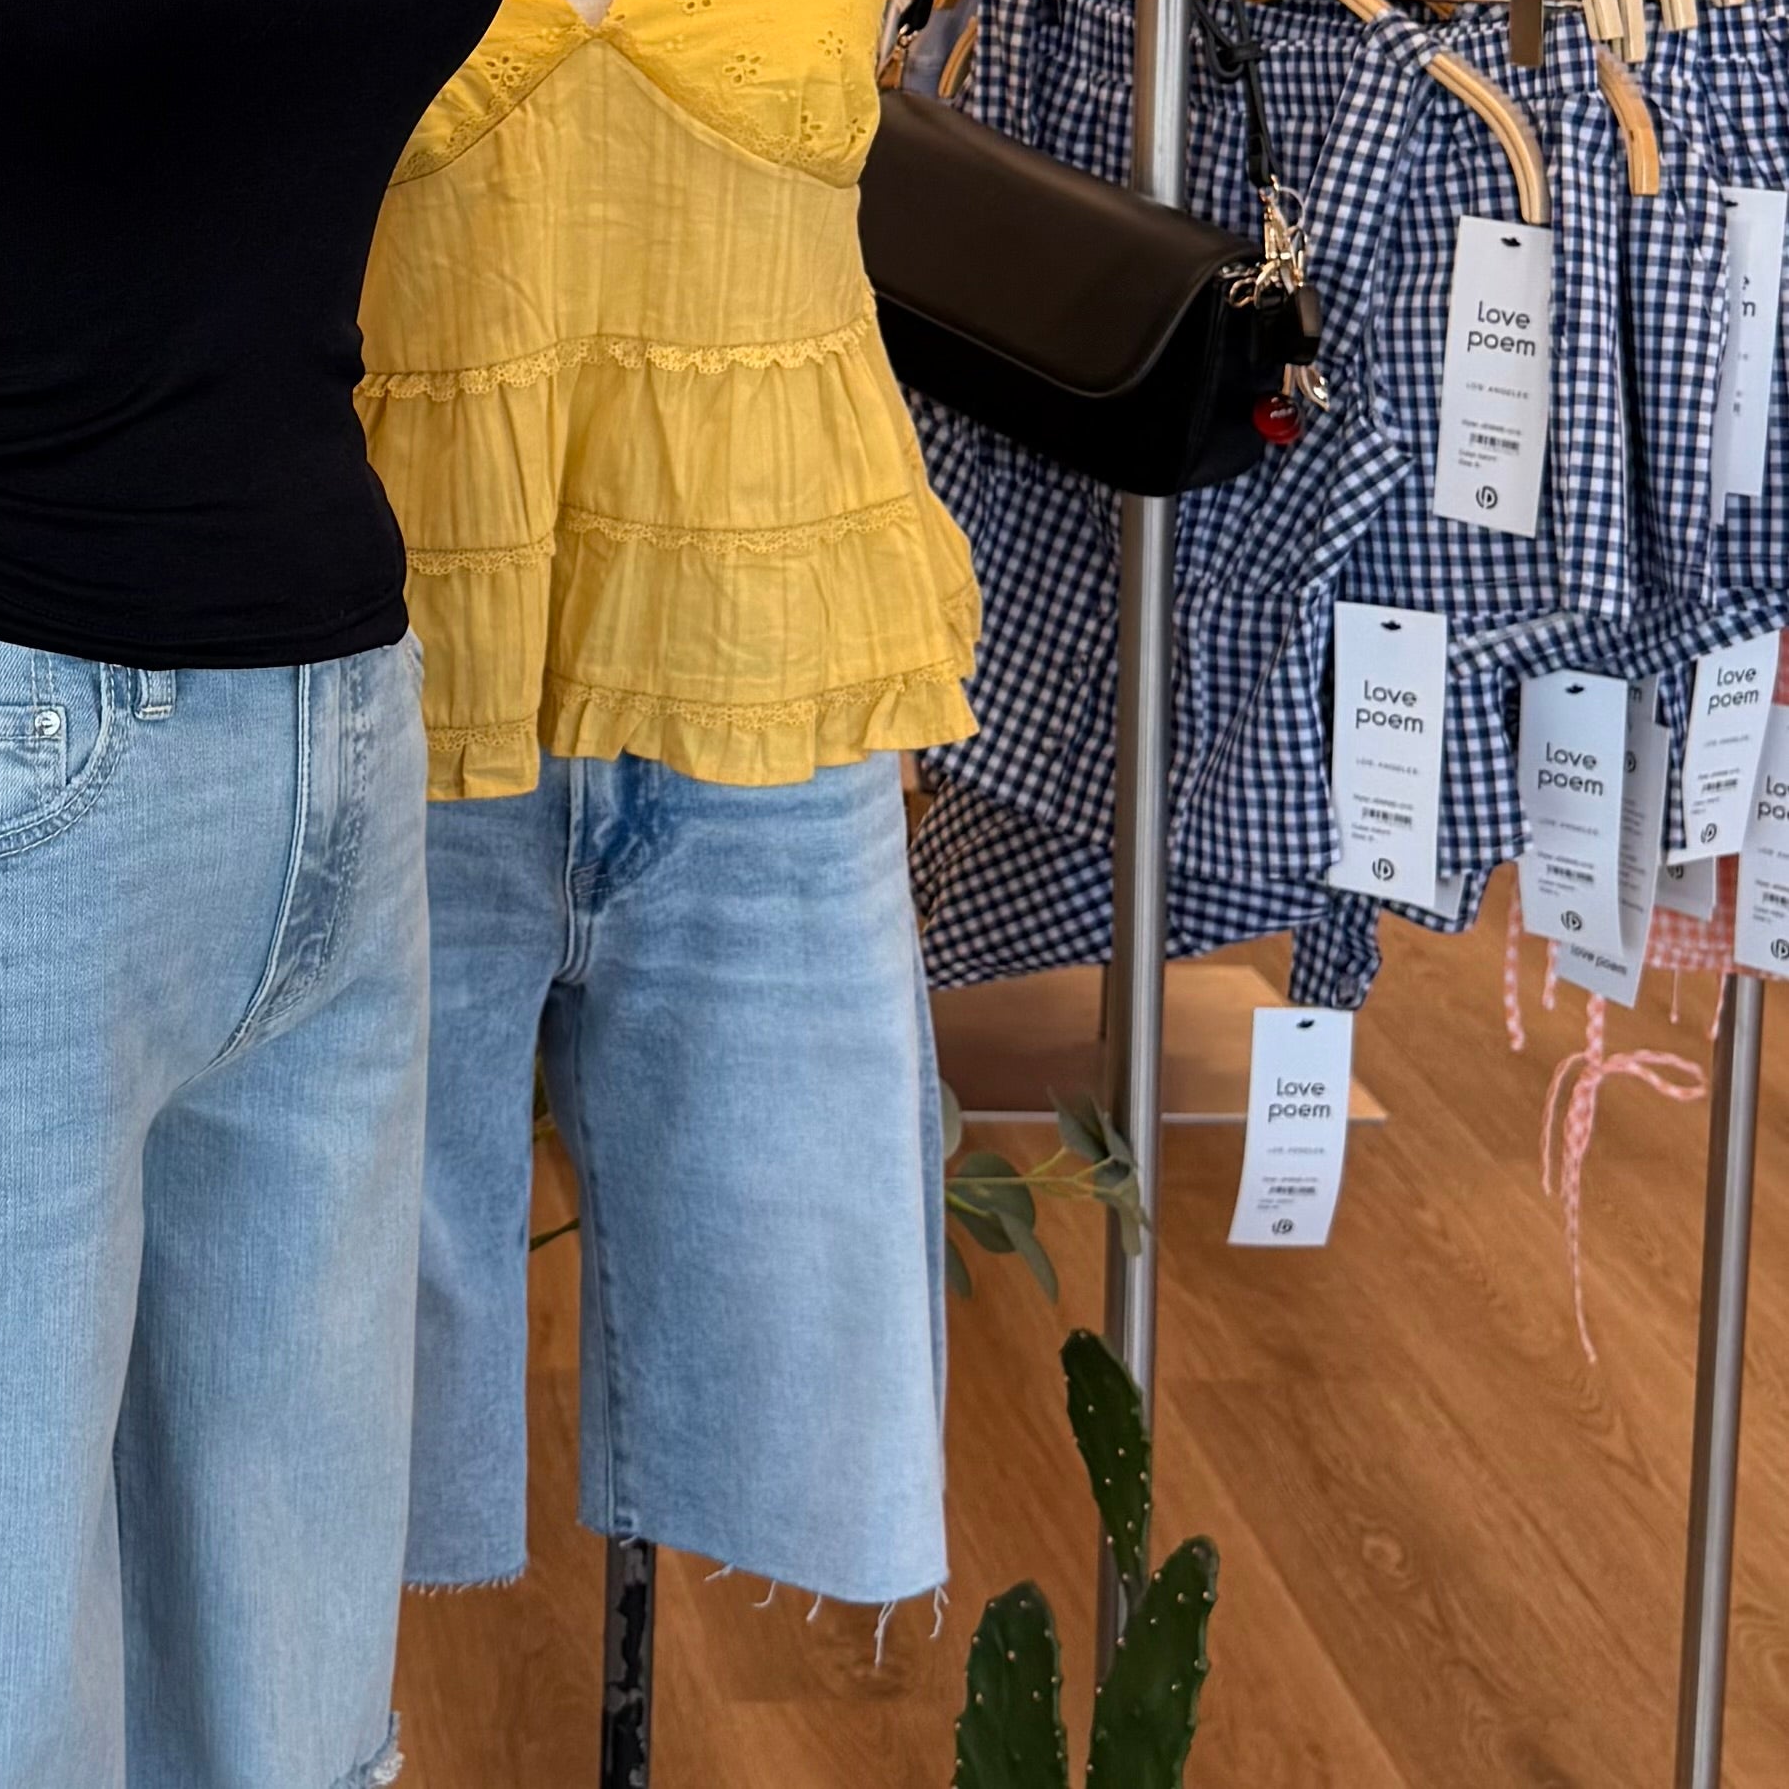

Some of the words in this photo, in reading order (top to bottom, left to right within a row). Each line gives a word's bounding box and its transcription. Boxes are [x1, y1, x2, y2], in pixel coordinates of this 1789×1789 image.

[1467, 331, 1537, 356] poem
[1707, 689, 1759, 713] poem
[1355, 708, 1423, 733] poem
[1537, 769, 1604, 796] poem
[1757, 801, 1789, 821] po
[1268, 1102, 1331, 1122] poem
